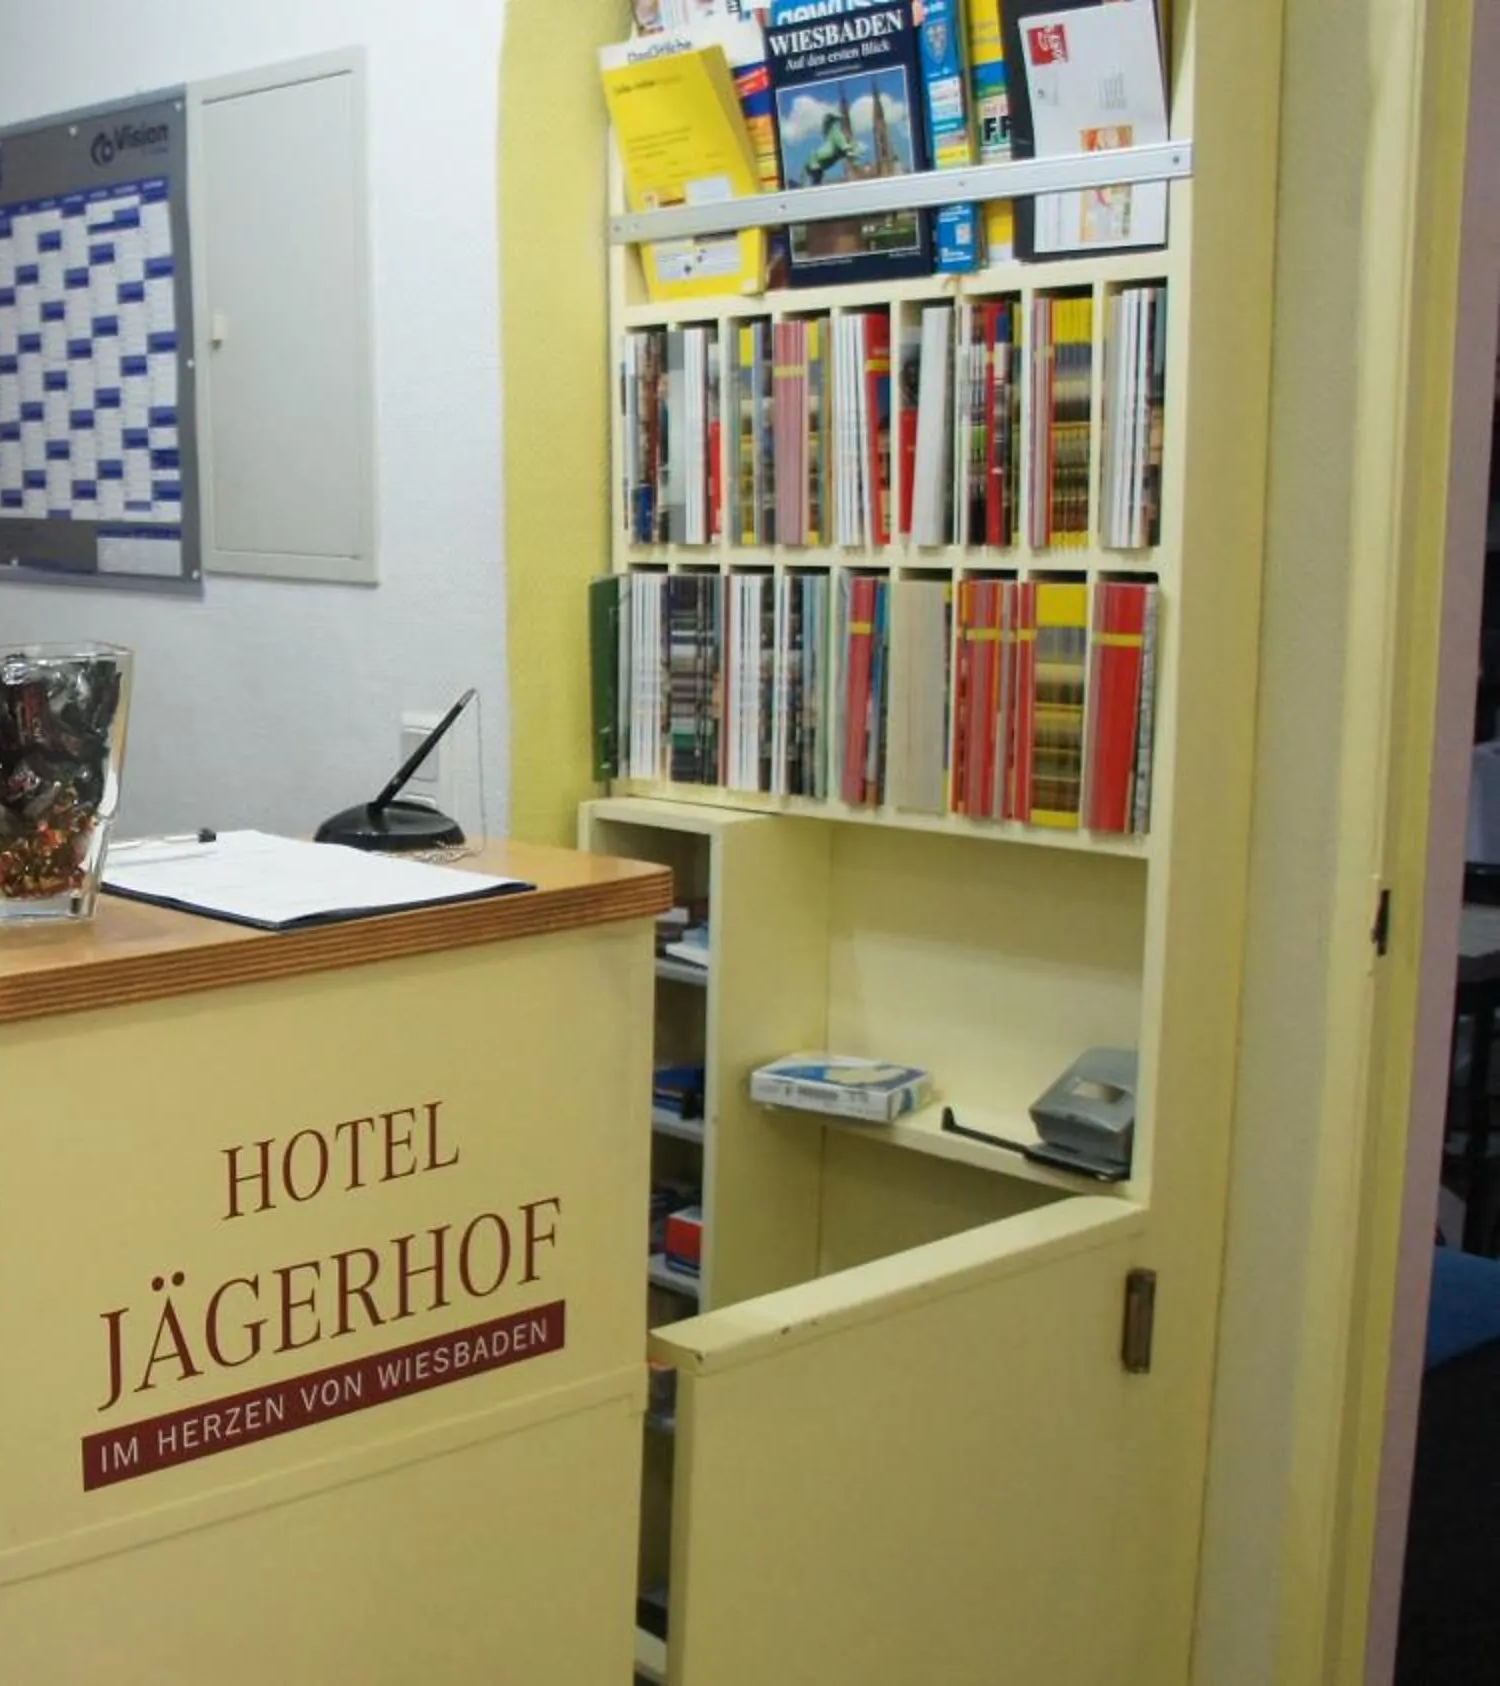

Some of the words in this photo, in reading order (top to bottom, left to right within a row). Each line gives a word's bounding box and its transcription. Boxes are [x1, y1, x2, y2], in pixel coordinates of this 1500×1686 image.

[769, 9, 904, 57] WIESBADEN
[785, 55, 805, 71] Auf
[807, 51, 826, 67] den
[827, 45, 861, 63] ersten
[861, 39, 891, 58] Blick
[115, 122, 169, 151] Vision
[221, 1100, 460, 1221] HOTEL
[97, 1197, 561, 1413] JÄGERHOF
[100, 1435, 140, 1474] IM
[157, 1394, 285, 1456] HERZEN
[300, 1371, 363, 1412] VON
[376, 1317, 550, 1390] WIESBADEN
